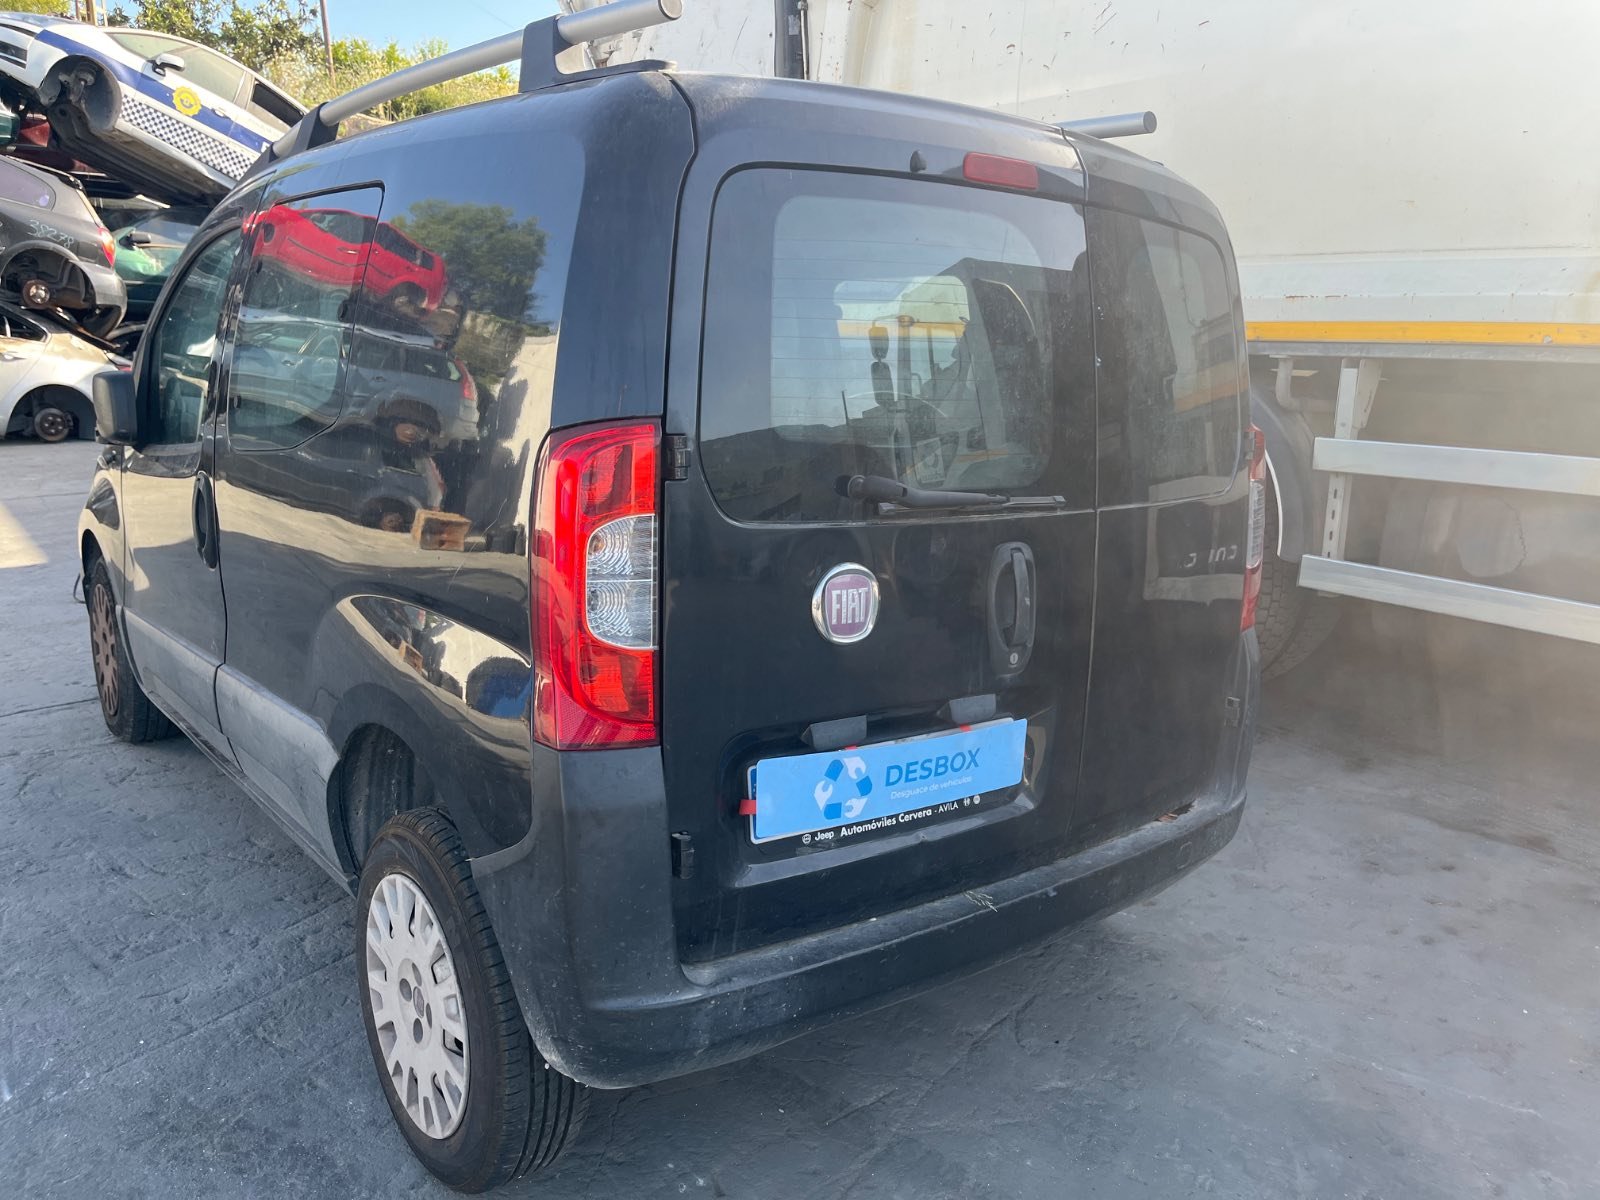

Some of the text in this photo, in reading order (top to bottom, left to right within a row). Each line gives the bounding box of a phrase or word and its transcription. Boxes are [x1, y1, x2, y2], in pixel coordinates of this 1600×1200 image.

[831, 587, 868, 625] FIAT
[885, 748, 981, 787] DESBOX
[890, 786, 929, 800] Desguace
[929, 783, 939, 792] de
[814, 830, 835, 842] Jeep
[840, 817, 897, 838] Automóviles
[898, 808, 933, 823] Cervera
